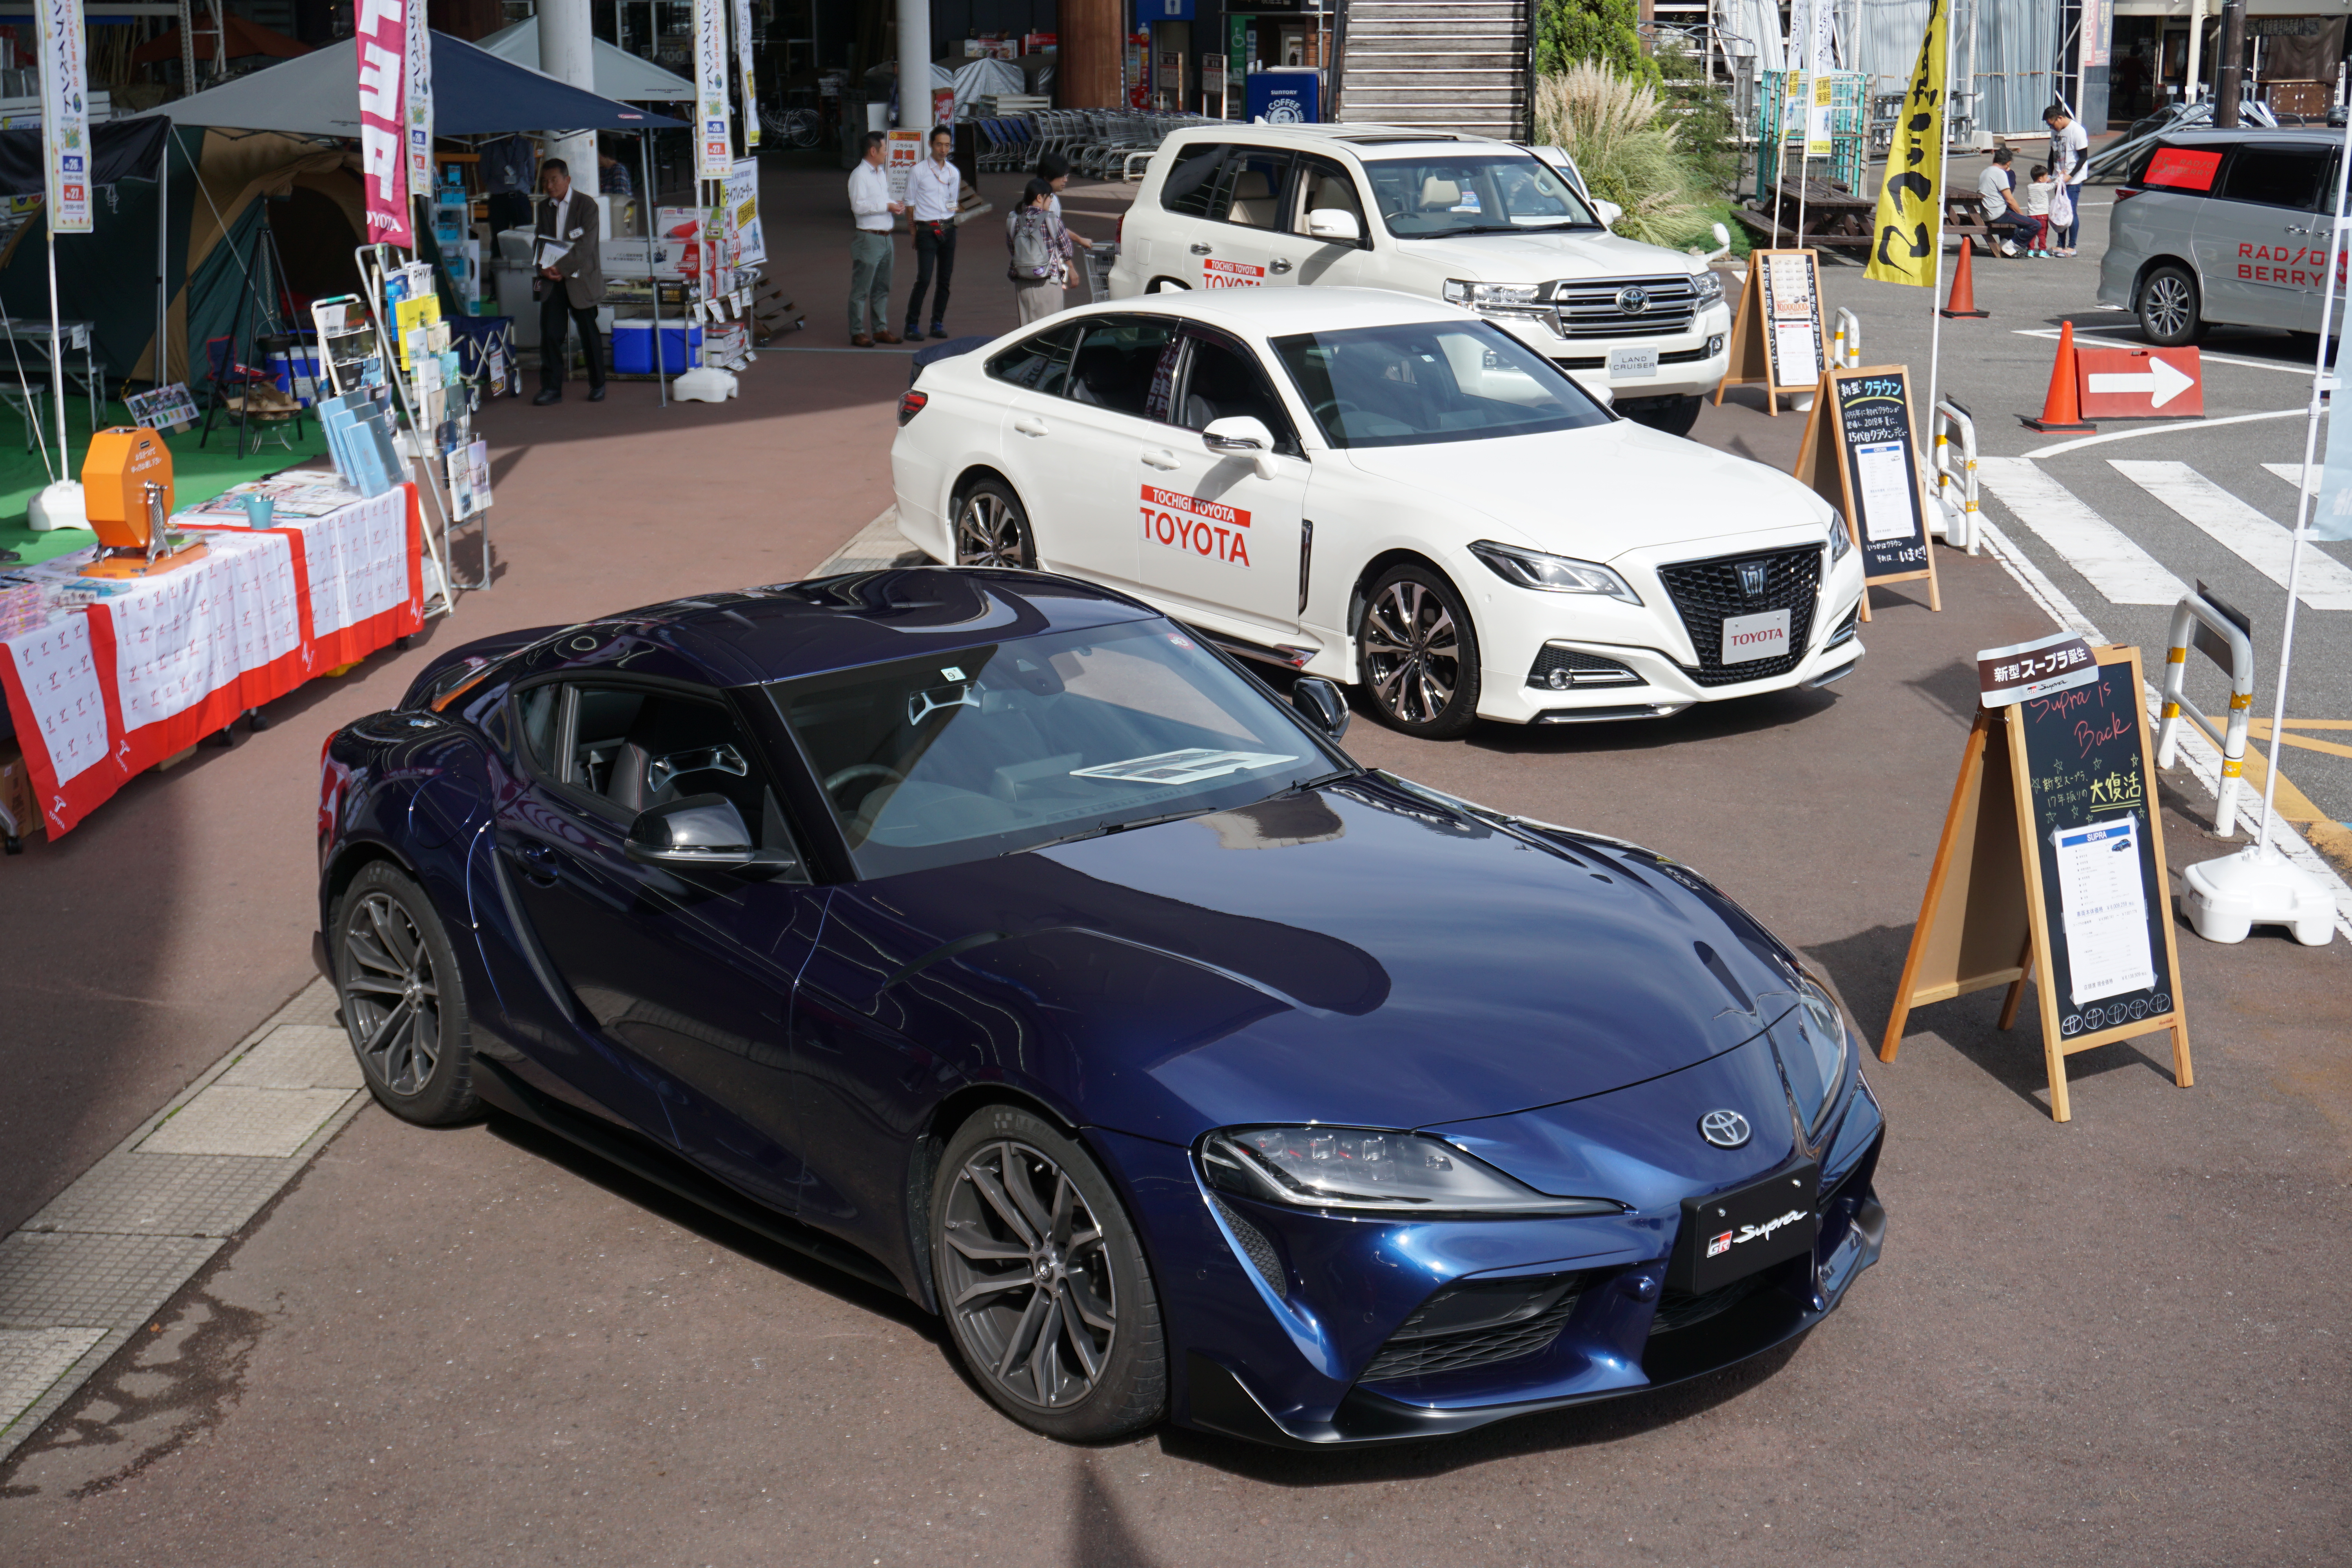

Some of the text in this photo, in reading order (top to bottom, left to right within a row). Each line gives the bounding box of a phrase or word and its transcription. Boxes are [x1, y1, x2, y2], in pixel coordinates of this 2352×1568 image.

[65, 0, 78, 87] はじめる車中泊
[1268, 98, 1300, 110] COFFEE
[893, 149, 915, 160] 禁煙
[2176, 167, 2211, 176] BERRY
[722, 182, 753, 205] ドライブレコーダー
[367, 211, 403, 233] OYOTA
[1211, 260, 1256, 275] TOCHIGI TOYOTA
[2238, 264, 2324, 287] BERRY
[1203, 273, 1260, 289] TOYO
[1841, 379, 1901, 397] 新型 クラウン
[1845, 406, 1900, 421] 1955年に初代クラウンが
[1848, 426, 1908, 443] 15代目クラウンデビュー
[1153, 489, 1235, 522] TOCHIGI TOYOTA
[1140, 506, 1250, 568] TOYOTA
[1731, 628, 1784, 646] TOYOTA
[1994, 647, 2087, 682] 新型スープラ誕生
[2027, 680, 2069, 695] GR Supra
[2030, 680, 2111, 724] Supra is
[2074, 712, 2132, 759] Back
[115, 753, 128, 773] TOYOTA
[2042, 771, 2088, 792] 新型スープラ、
[2090, 771, 2141, 803] 大復活
[2047, 789, 2087, 808] 17年振りの
[49, 810, 65, 831] TOYOTA
[2087, 831, 2107, 842] SUPRA
[2077, 906, 2103, 917] 車両本体価格
[2097, 978, 2113, 987] 現金価格
[1708, 1209, 1808, 1256] GR Supra
